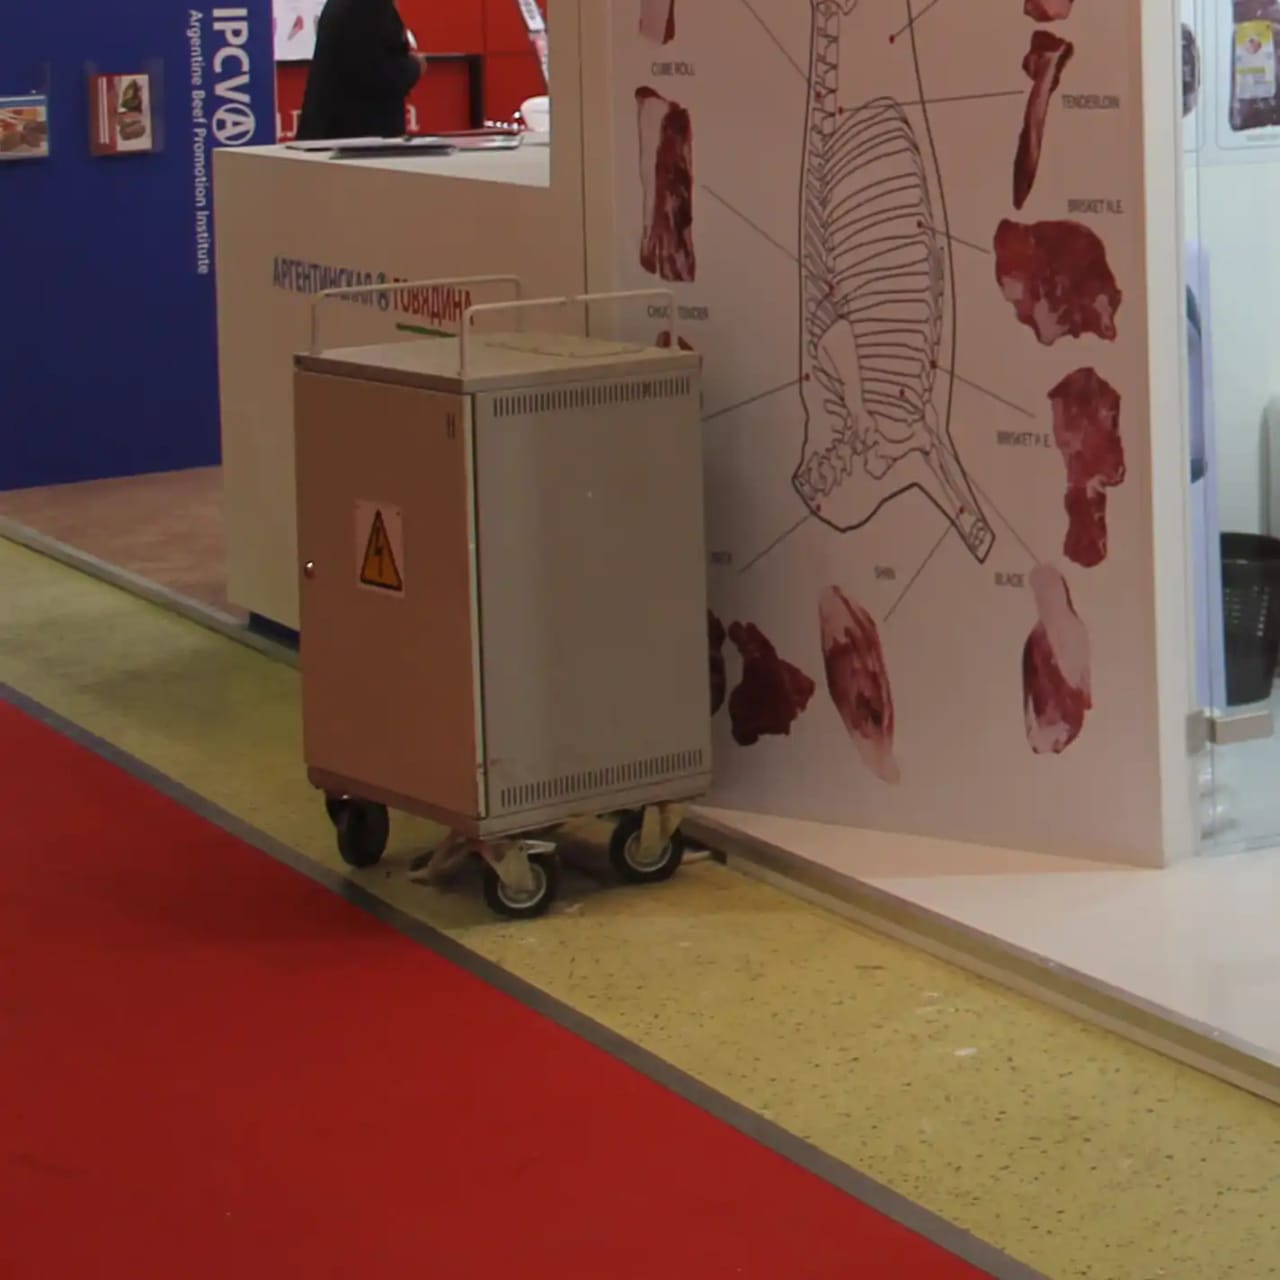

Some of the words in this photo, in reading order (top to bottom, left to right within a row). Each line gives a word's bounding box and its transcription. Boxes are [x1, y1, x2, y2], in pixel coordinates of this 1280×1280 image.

[186, 9, 206, 86] Argentine
[212, 7, 256, 146] IPCVA
[191, 89, 208, 125] Beef
[193, 127, 209, 208] Promotion
[195, 210, 212, 275] Institute
